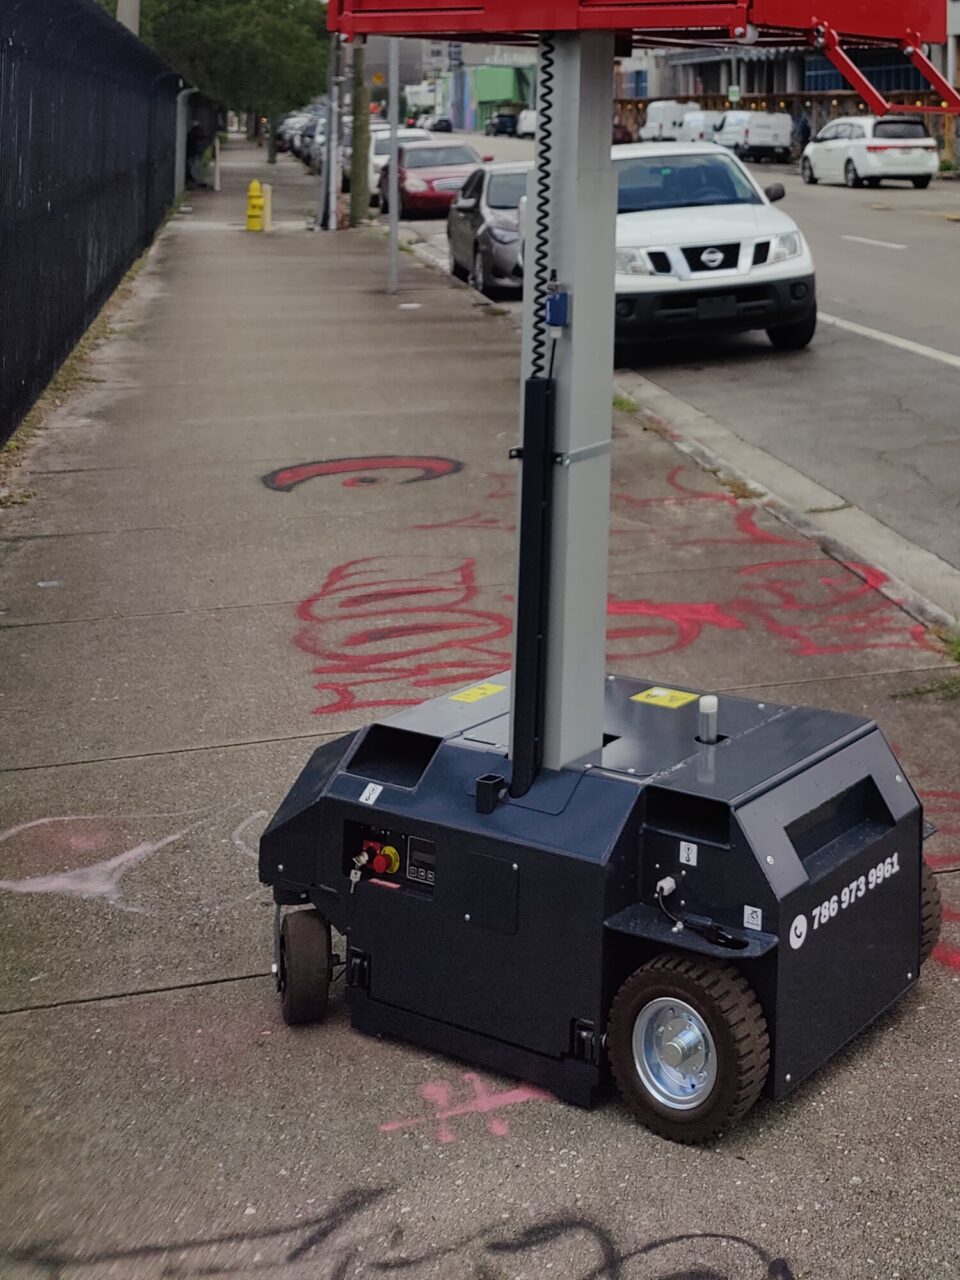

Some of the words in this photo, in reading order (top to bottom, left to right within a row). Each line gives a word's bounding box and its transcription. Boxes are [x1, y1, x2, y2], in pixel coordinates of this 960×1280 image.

[812, 894, 839, 930] 786
[841, 875, 866, 910] 973
[868, 852, 900, 889] 9961
